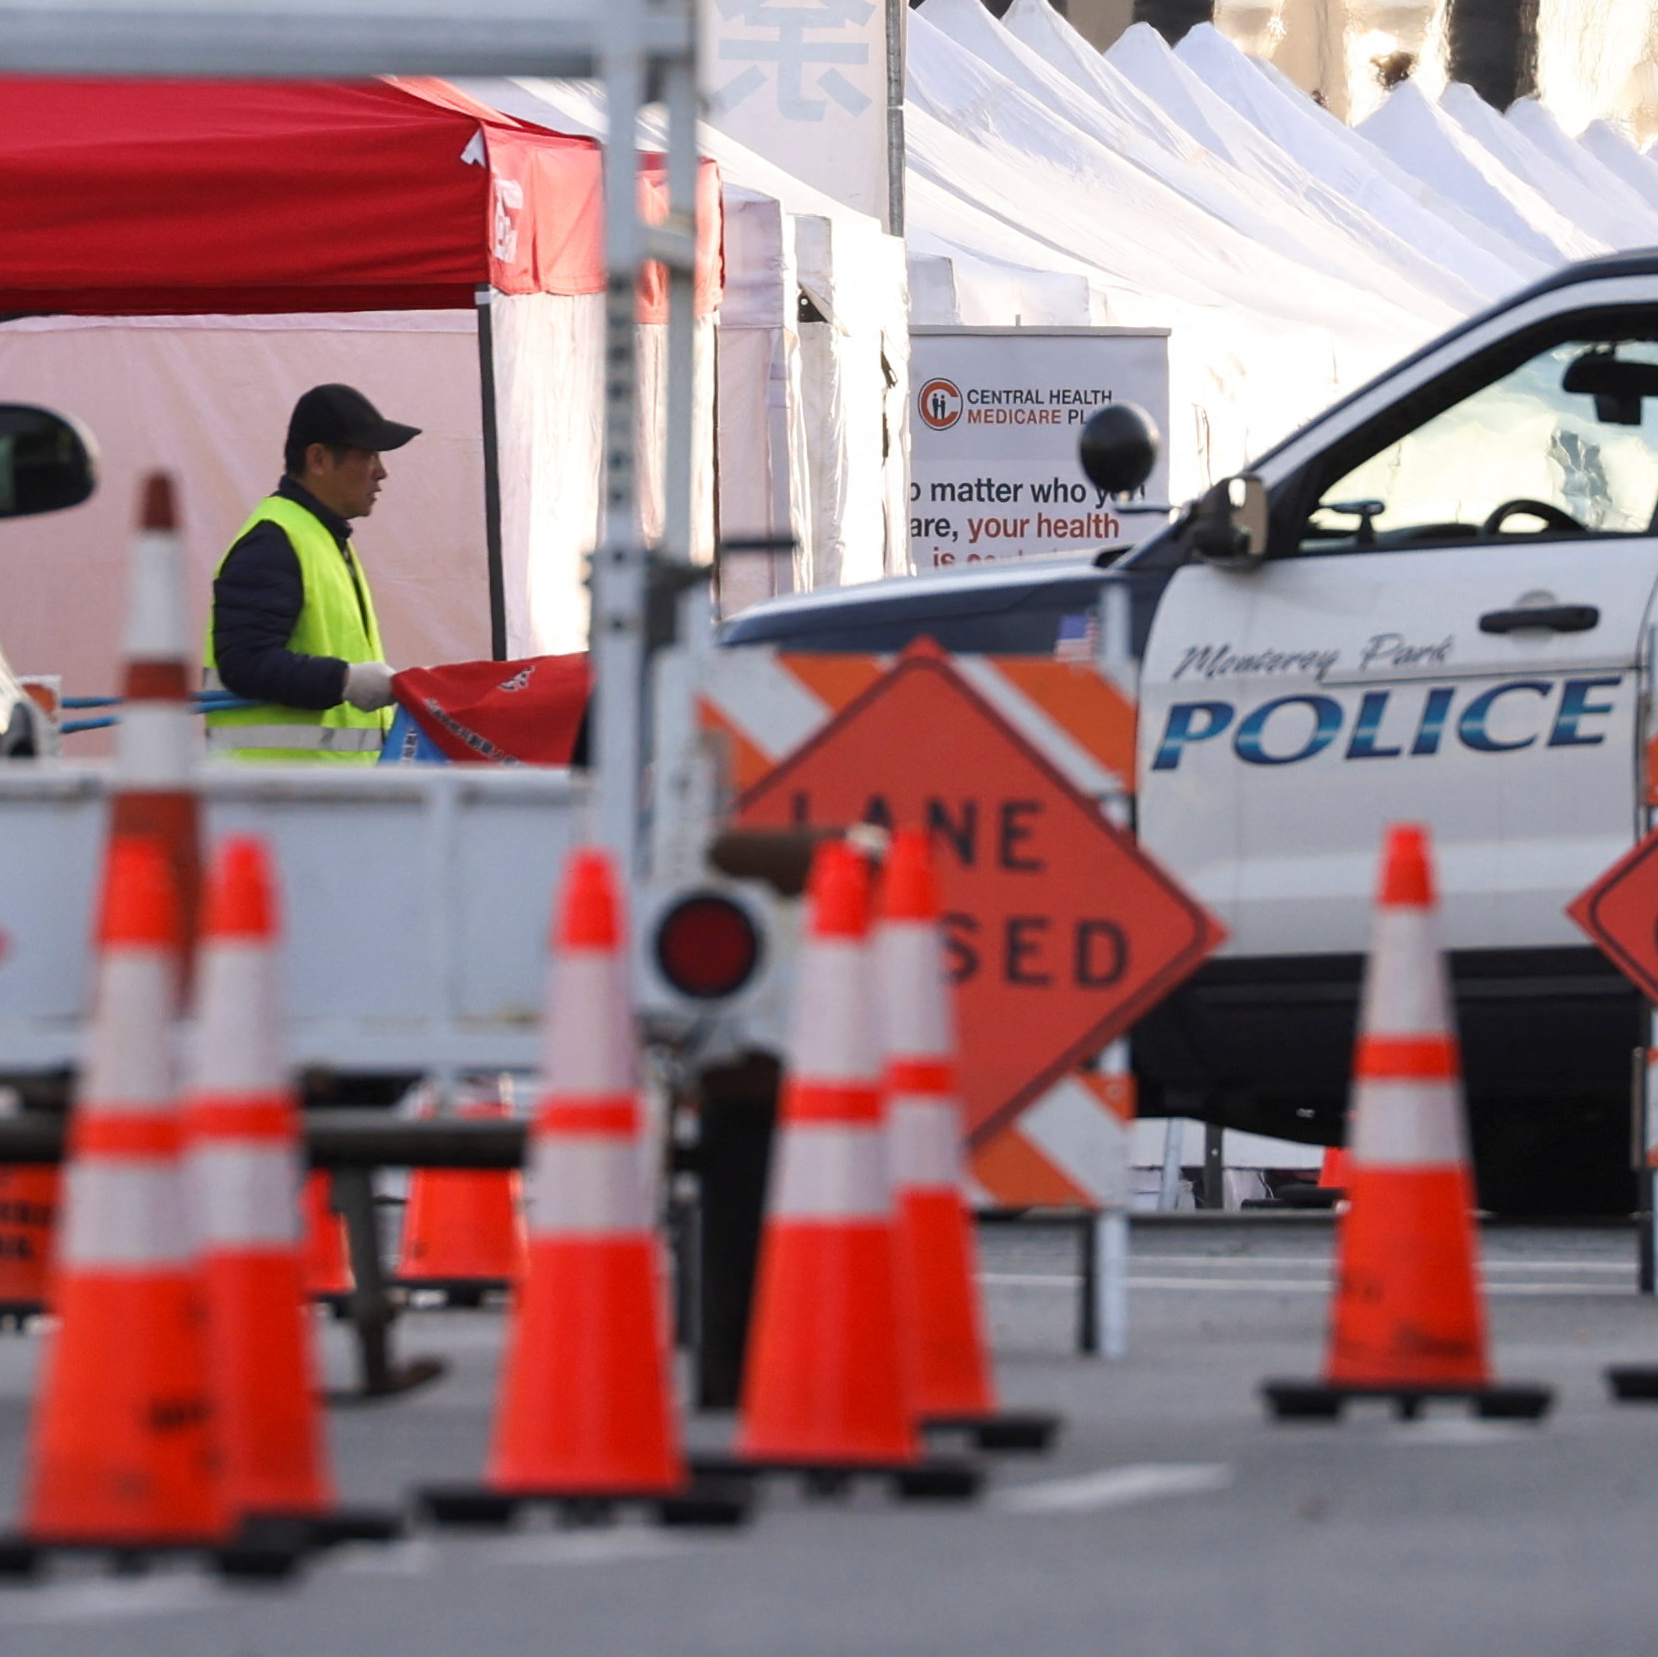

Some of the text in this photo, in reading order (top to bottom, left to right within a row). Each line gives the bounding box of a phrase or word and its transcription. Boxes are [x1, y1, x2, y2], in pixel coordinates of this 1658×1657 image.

[967, 389, 1112, 405] CENTRAL HEALTH
[967, 408, 1089, 425] MEDICARE PL
[930, 478, 1023, 503] matter
[1030, 477, 1087, 503] who
[910, 513, 1120, 543] are, your health
[1171, 633, 1455, 683] Monterey Park
[1150, 675, 1623, 771] POLICE
[939, 912, 1131, 989] SED
